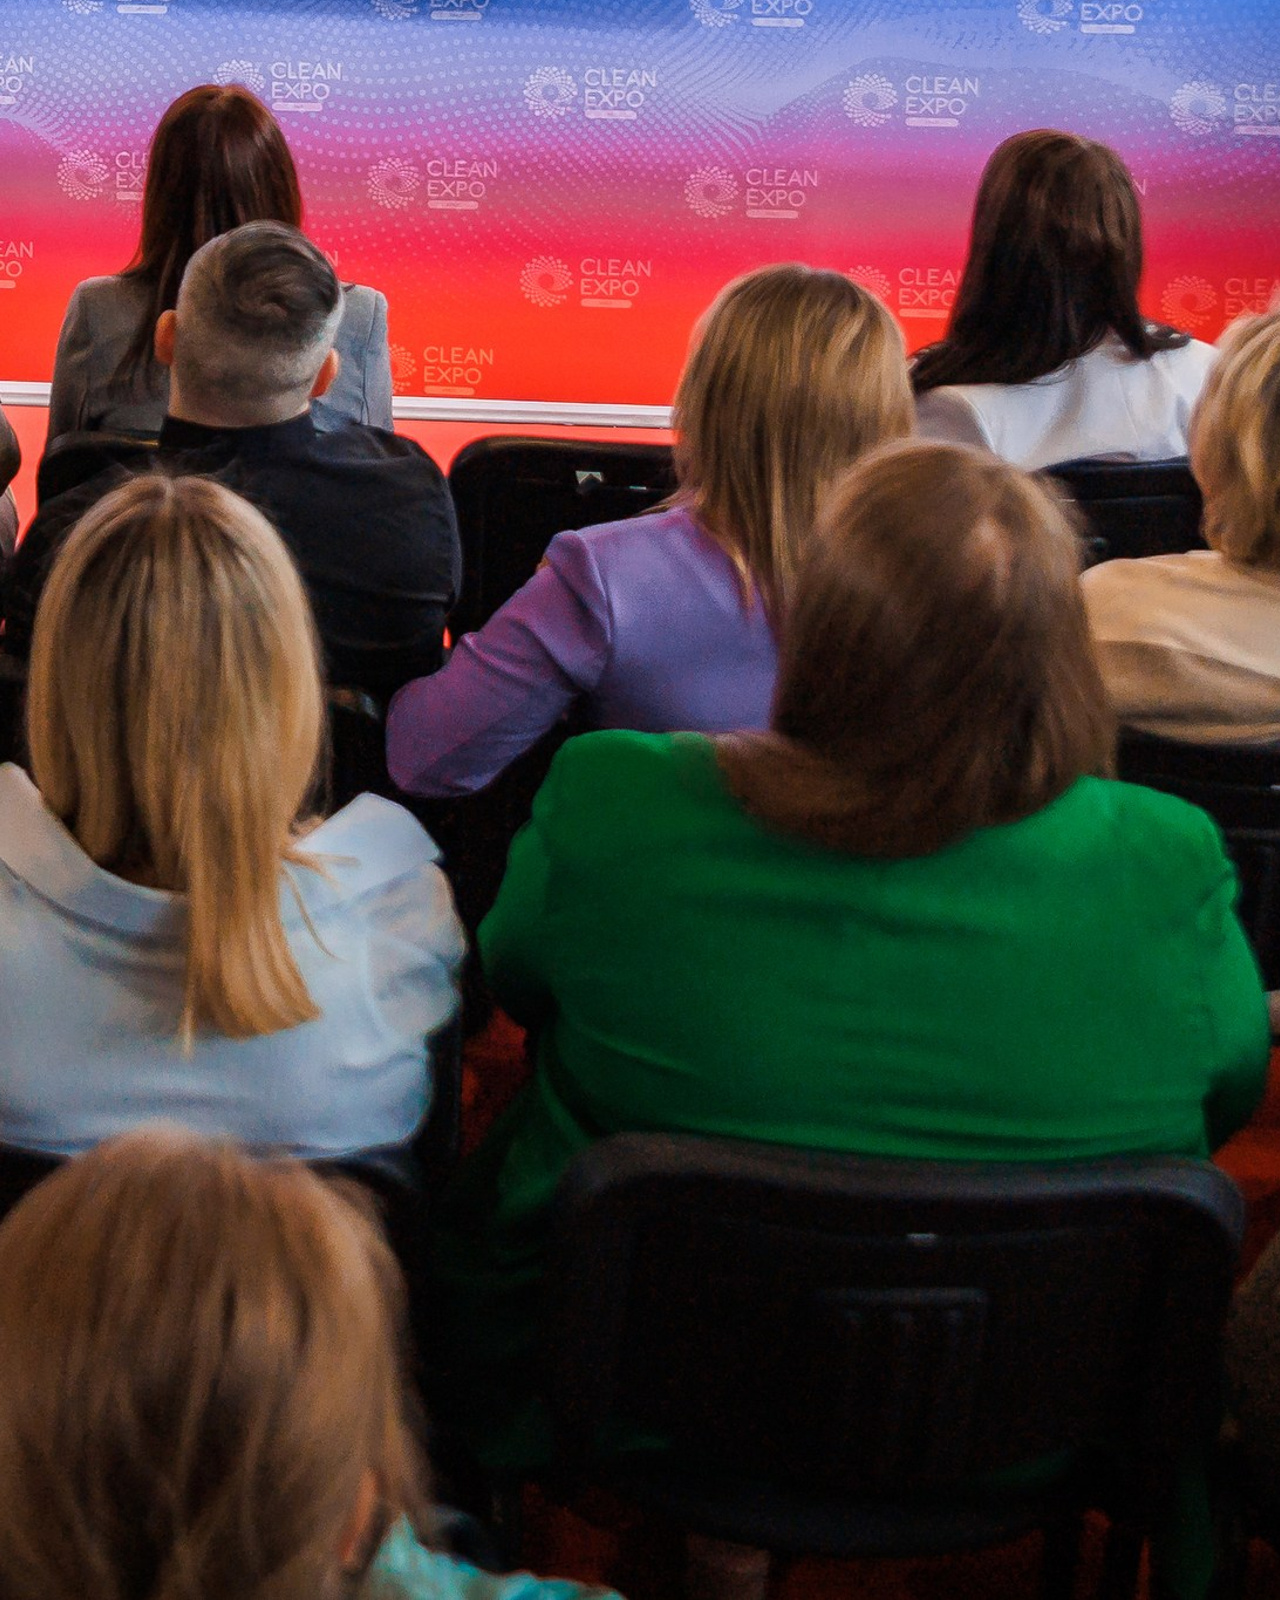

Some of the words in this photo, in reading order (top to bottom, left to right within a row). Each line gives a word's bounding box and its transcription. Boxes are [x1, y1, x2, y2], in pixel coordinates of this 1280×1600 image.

[1081, 3, 1144, 22] EXPO
[271, 61, 343, 81] CLEAN
[584, 68, 657, 88] CLEAN
[272, 83, 330, 100] EXPO
[906, 75, 980, 96] CLEAN
[585, 90, 644, 108] EXPO
[906, 97, 966, 116] EXPO
[426, 160, 498, 179] CLEAN
[746, 168, 819, 188] CLEAN
[427, 181, 486, 198] EXPO
[746, 189, 806, 208] EXPO
[580, 258, 652, 278] CLEAN
[580, 277, 640, 297] EXPO
[424, 346, 494, 366] CLEAN
[424, 366, 482, 385] EXPO
